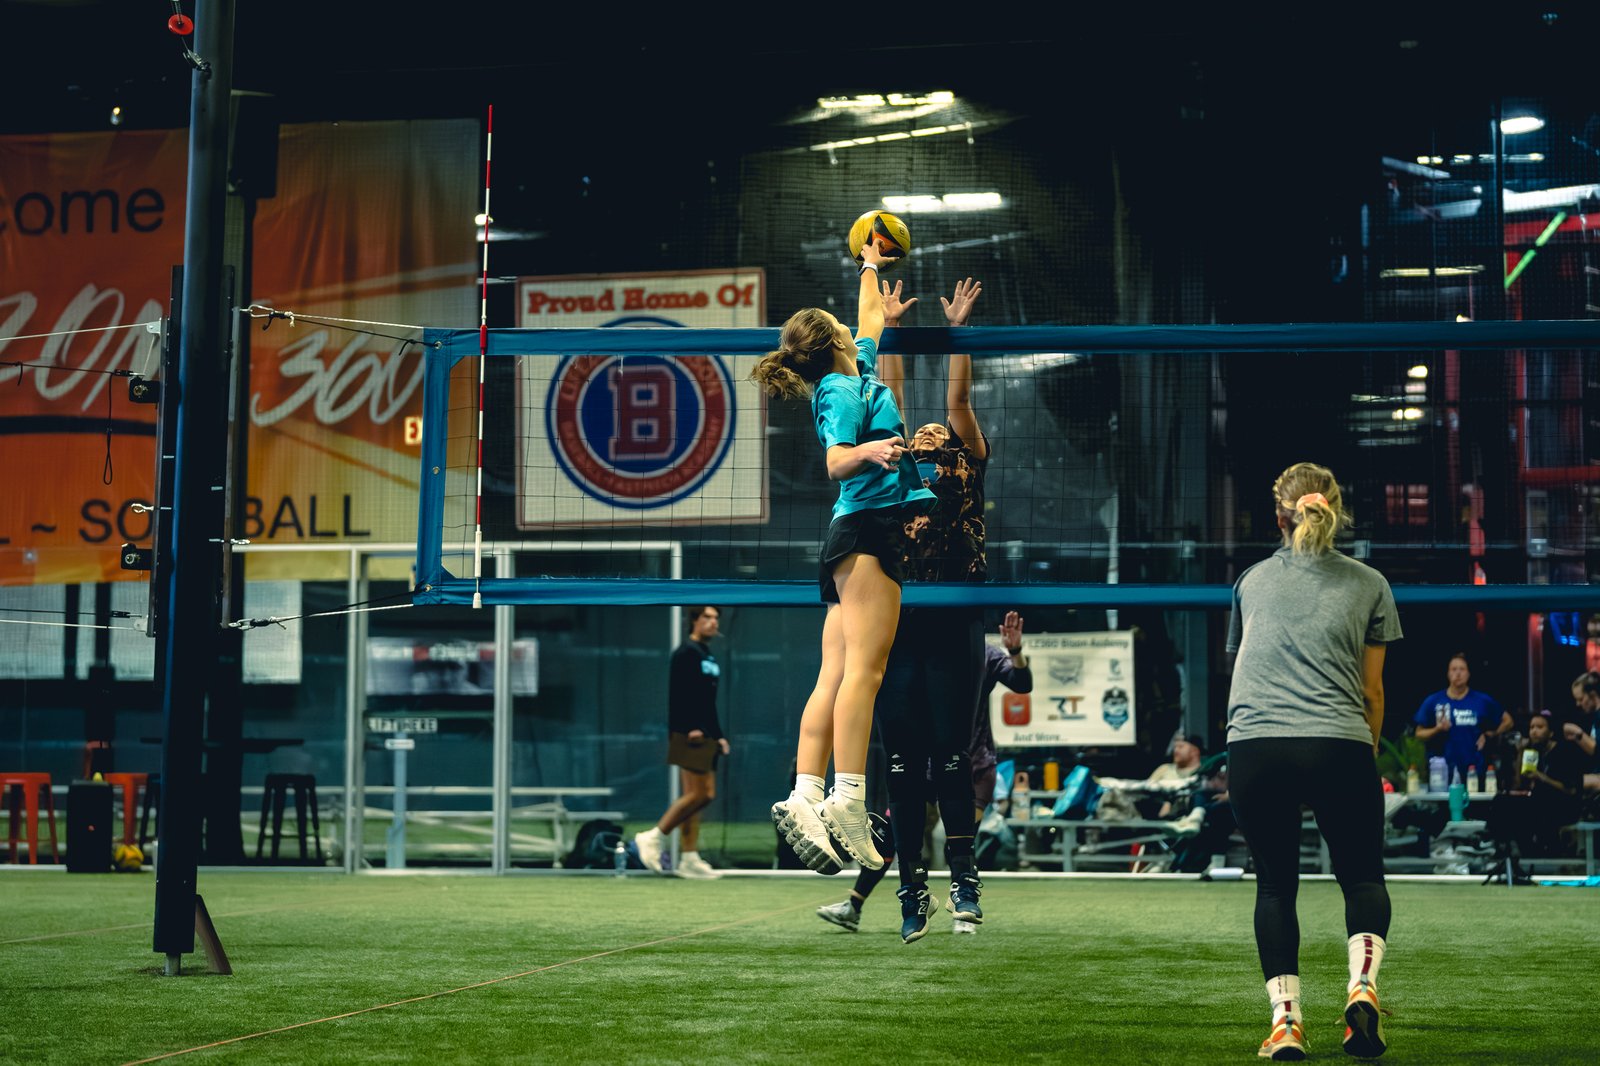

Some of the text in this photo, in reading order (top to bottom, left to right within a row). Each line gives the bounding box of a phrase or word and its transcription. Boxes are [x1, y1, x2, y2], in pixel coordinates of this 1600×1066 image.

[528, 283, 756, 315] Proud Home Of
[78, 493, 371, 544] SOBALL
